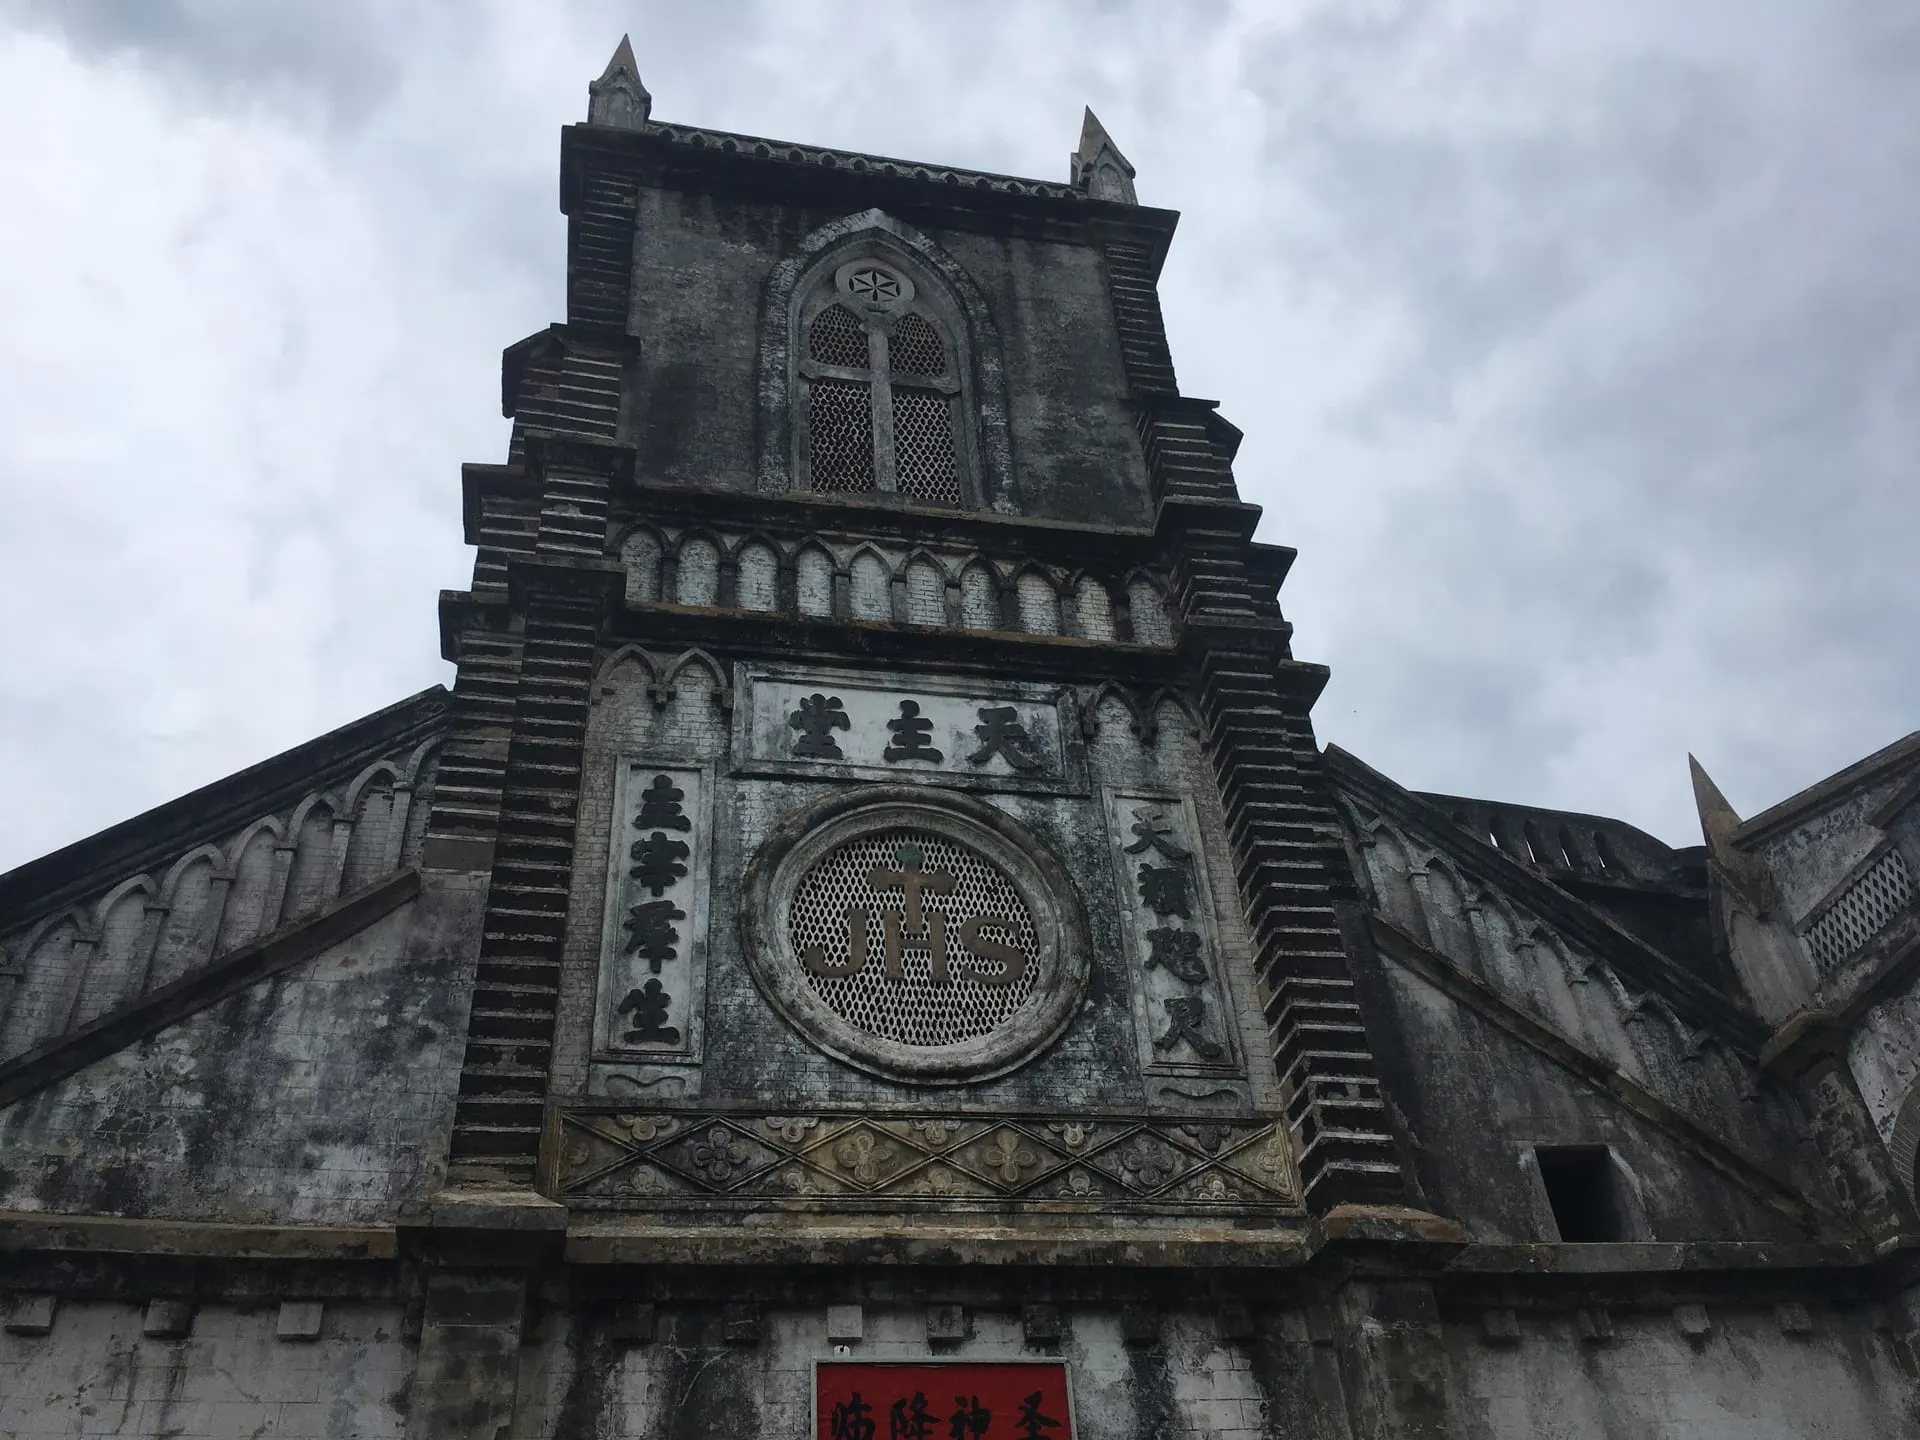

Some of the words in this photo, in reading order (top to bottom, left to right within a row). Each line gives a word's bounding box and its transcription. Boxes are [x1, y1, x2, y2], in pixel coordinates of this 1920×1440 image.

[789, 693, 1045, 776] 天主堂
[802, 907, 1026, 986] JHS
